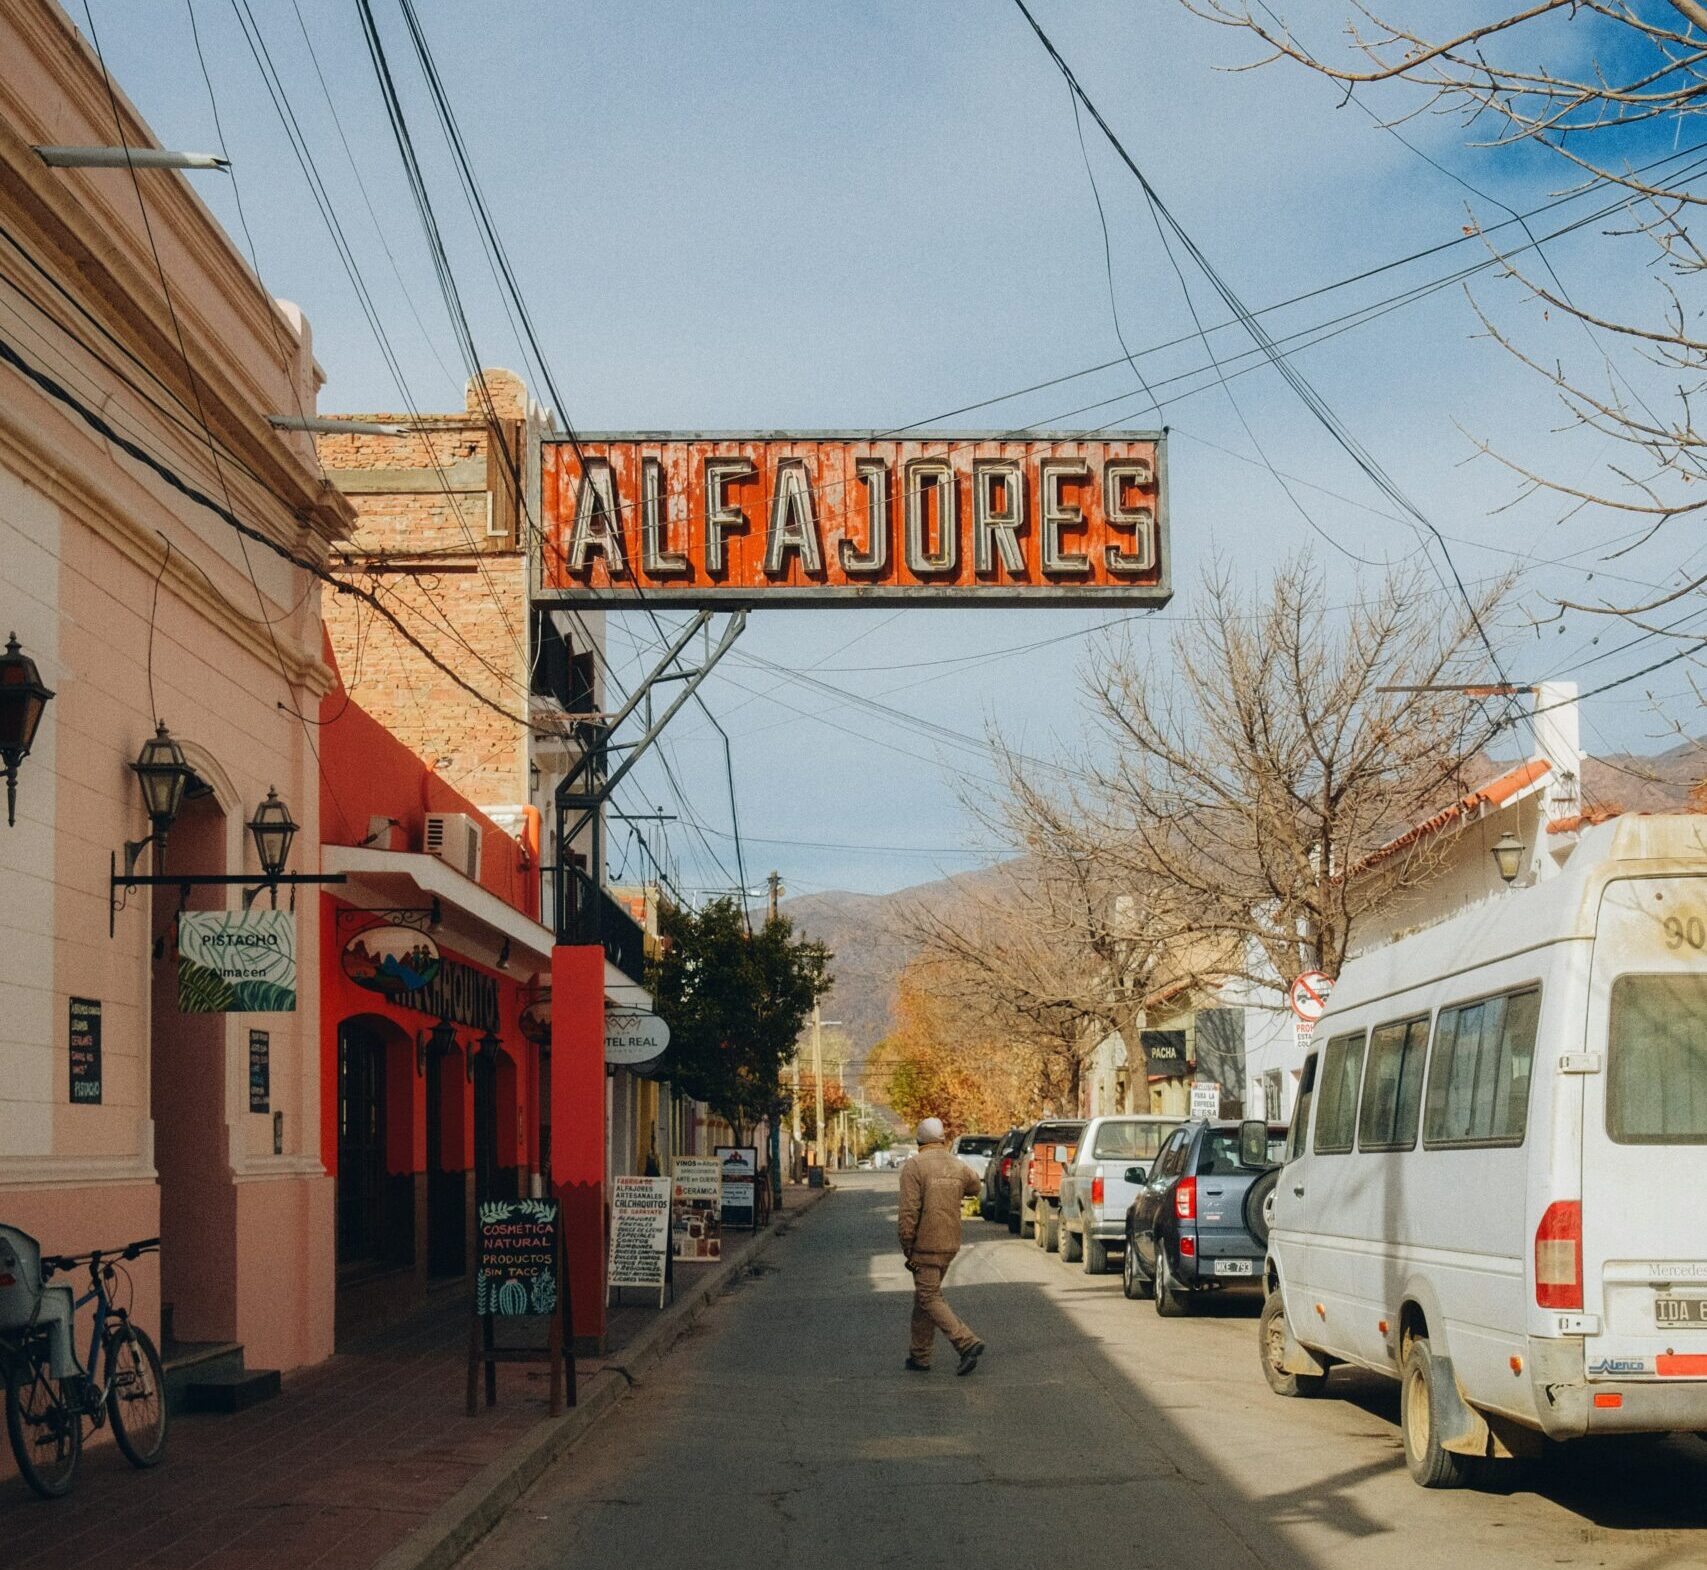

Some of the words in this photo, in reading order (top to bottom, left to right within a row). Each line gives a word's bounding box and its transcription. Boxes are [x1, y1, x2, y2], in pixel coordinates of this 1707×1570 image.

[568, 456, 1157, 574] ALFAJORES
[1663, 916, 1706, 950] 90
[202, 933, 278, 947] PISTACHO
[209, 967, 267, 979] Almacen
[604, 1037, 625, 1047] TEL
[628, 1037, 658, 1047] REAL
[1151, 1047, 1176, 1059] PACHA
[1208, 1092, 1215, 1100] LA
[1193, 1100, 1215, 1108] EMPRESA
[683, 1187, 718, 1195] CERÁMICA
[615, 1200, 668, 1209] CALCHAQUITOS
[484, 1237, 551, 1249] NATURAL
[483, 1254, 553, 1265] PRODUCTOS
[484, 1268, 502, 1277] SIN
[508, 1267, 539, 1277] TACC
[1649, 1263, 1707, 1277] Mercedes
[1657, 1301, 1690, 1321] IDA
